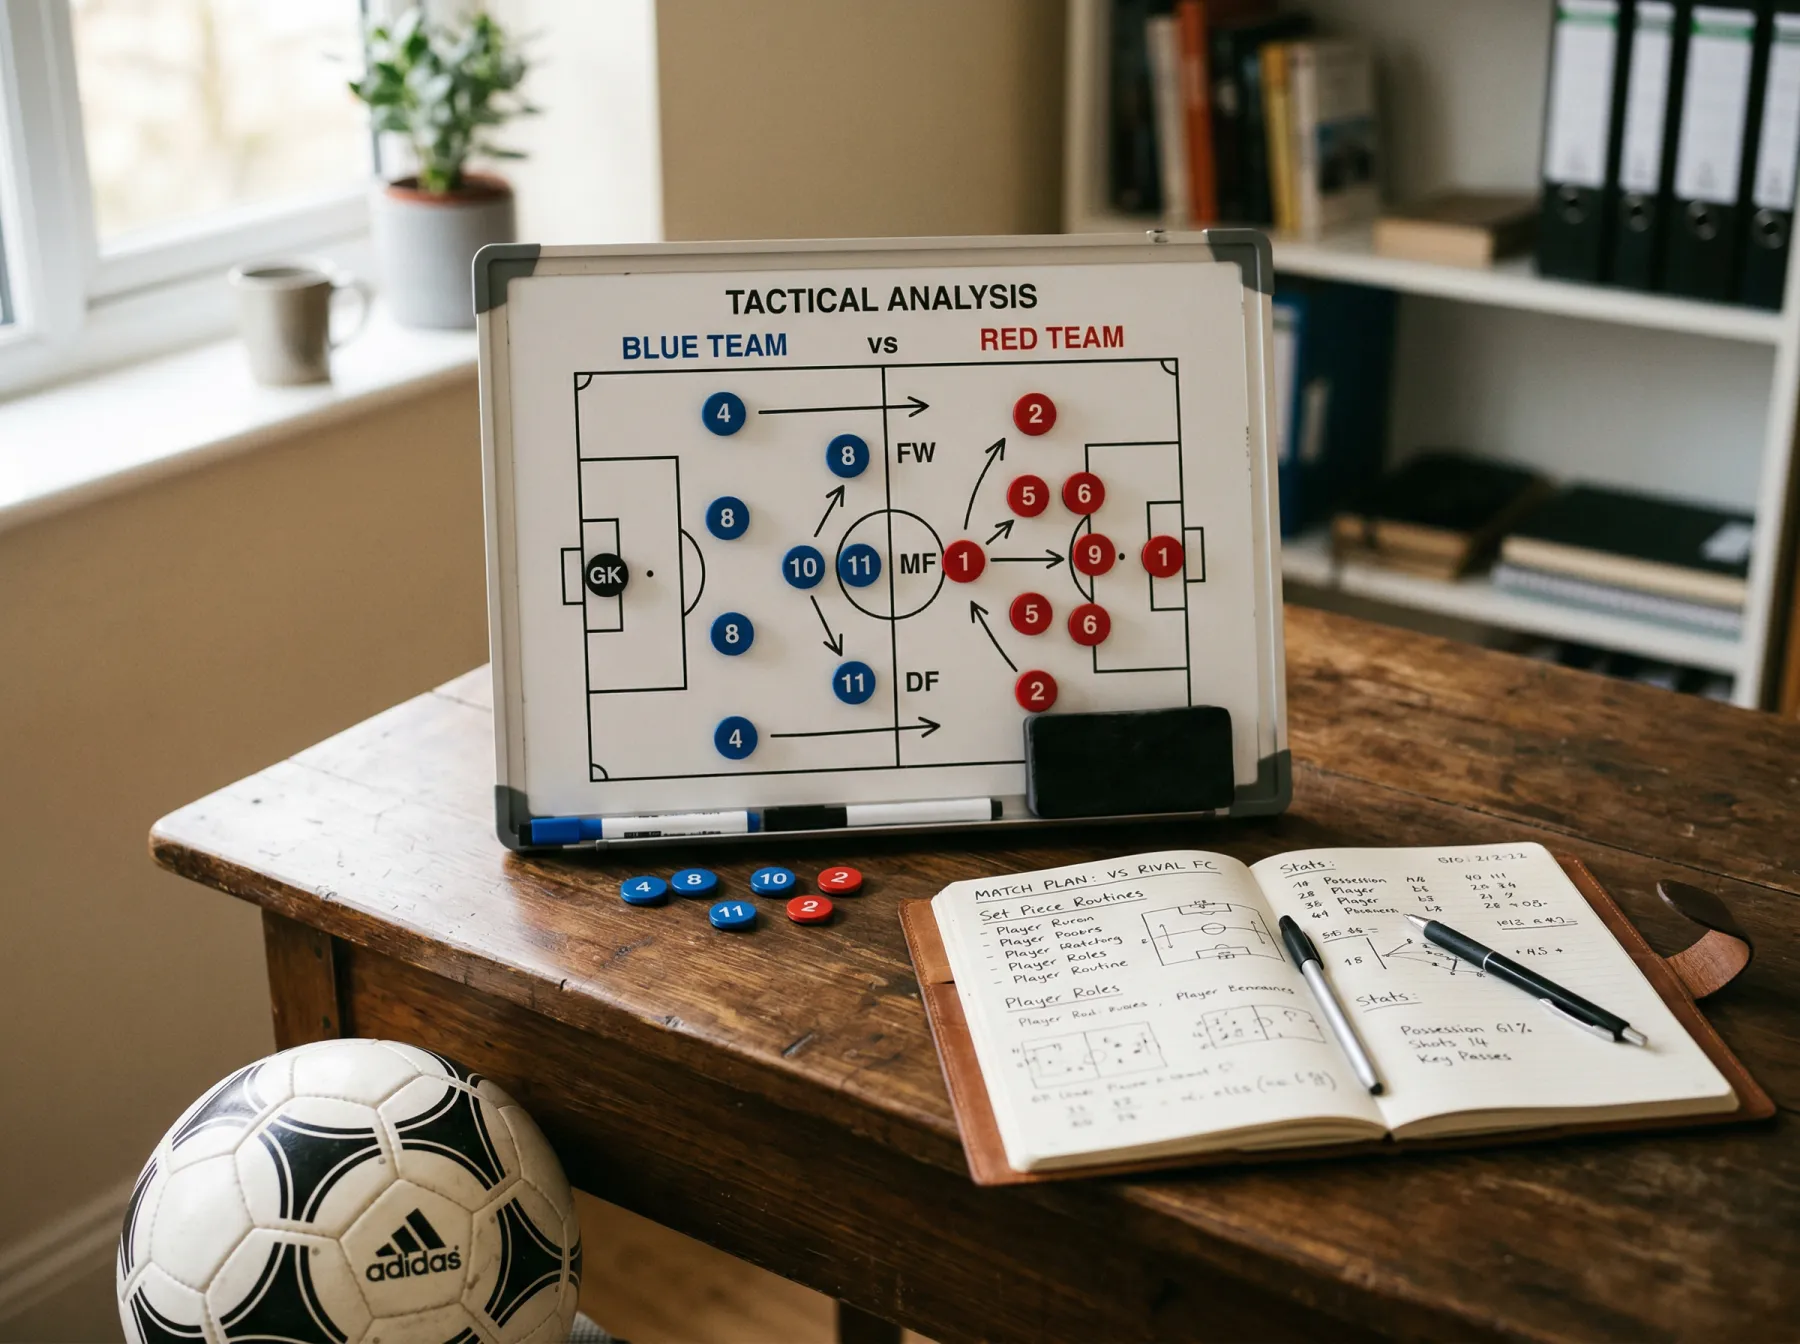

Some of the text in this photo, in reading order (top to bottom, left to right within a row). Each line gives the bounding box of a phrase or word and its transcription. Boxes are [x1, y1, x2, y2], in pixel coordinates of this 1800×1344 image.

[725, 281, 1038, 316] TACTICAL ANALYSIS
[622, 334, 699, 360] BLUE
[706, 332, 788, 358] TEAM
[980, 326, 1038, 351] RED
[1045, 325, 1124, 350] TEAM
[717, 403, 731, 423] 4
[1029, 403, 1043, 423] 2
[841, 446, 855, 466] 8
[896, 441, 937, 464] FW
[1021, 486, 1035, 506] 5
[1077, 483, 1091, 503] 6
[721, 508, 734, 528] 8
[848, 555, 870, 575] 11
[899, 552, 937, 575] MF
[1088, 545, 1102, 565] 9
[590, 566, 622, 584] GK
[790, 557, 817, 578] 10
[1025, 604, 1039, 624] 5
[725, 624, 739, 644] 8
[1083, 615, 1097, 634] 6
[843, 673, 866, 694] 11
[905, 670, 940, 693] DF
[1031, 681, 1044, 701] 2
[729, 729, 742, 748] 4
[635, 881, 652, 893] 4
[686, 873, 702, 885] 8
[759, 872, 787, 885] 10
[830, 871, 849, 884] 2
[975, 884, 1033, 900] MATCH
[1107, 868, 1129, 879] VS
[1138, 861, 1187, 875] RIVAL
[1193, 860, 1218, 871] FC
[1323, 876, 1388, 886] Possession
[1330, 886, 1376, 898] Player
[718, 904, 744, 918] 11
[800, 900, 819, 912] 2
[979, 889, 1145, 922] Set Piece Routines
[996, 923, 1043, 937] Player
[999, 935, 1045, 949] Player
[1004, 946, 1051, 960] Player
[1008, 950, 1108, 972] Player Roles
[1013, 959, 1129, 985] Player Routine
[1005, 983, 1121, 1010] Player Roles
[1176, 988, 1218, 1001] Player
[1018, 1014, 1062, 1028] Player
[1400, 1022, 1533, 1037] Possession 61%
[1408, 1037, 1489, 1049] Shots 14
[1416, 1050, 1513, 1067] Key Passes
[366, 1250, 463, 1283] adidas
